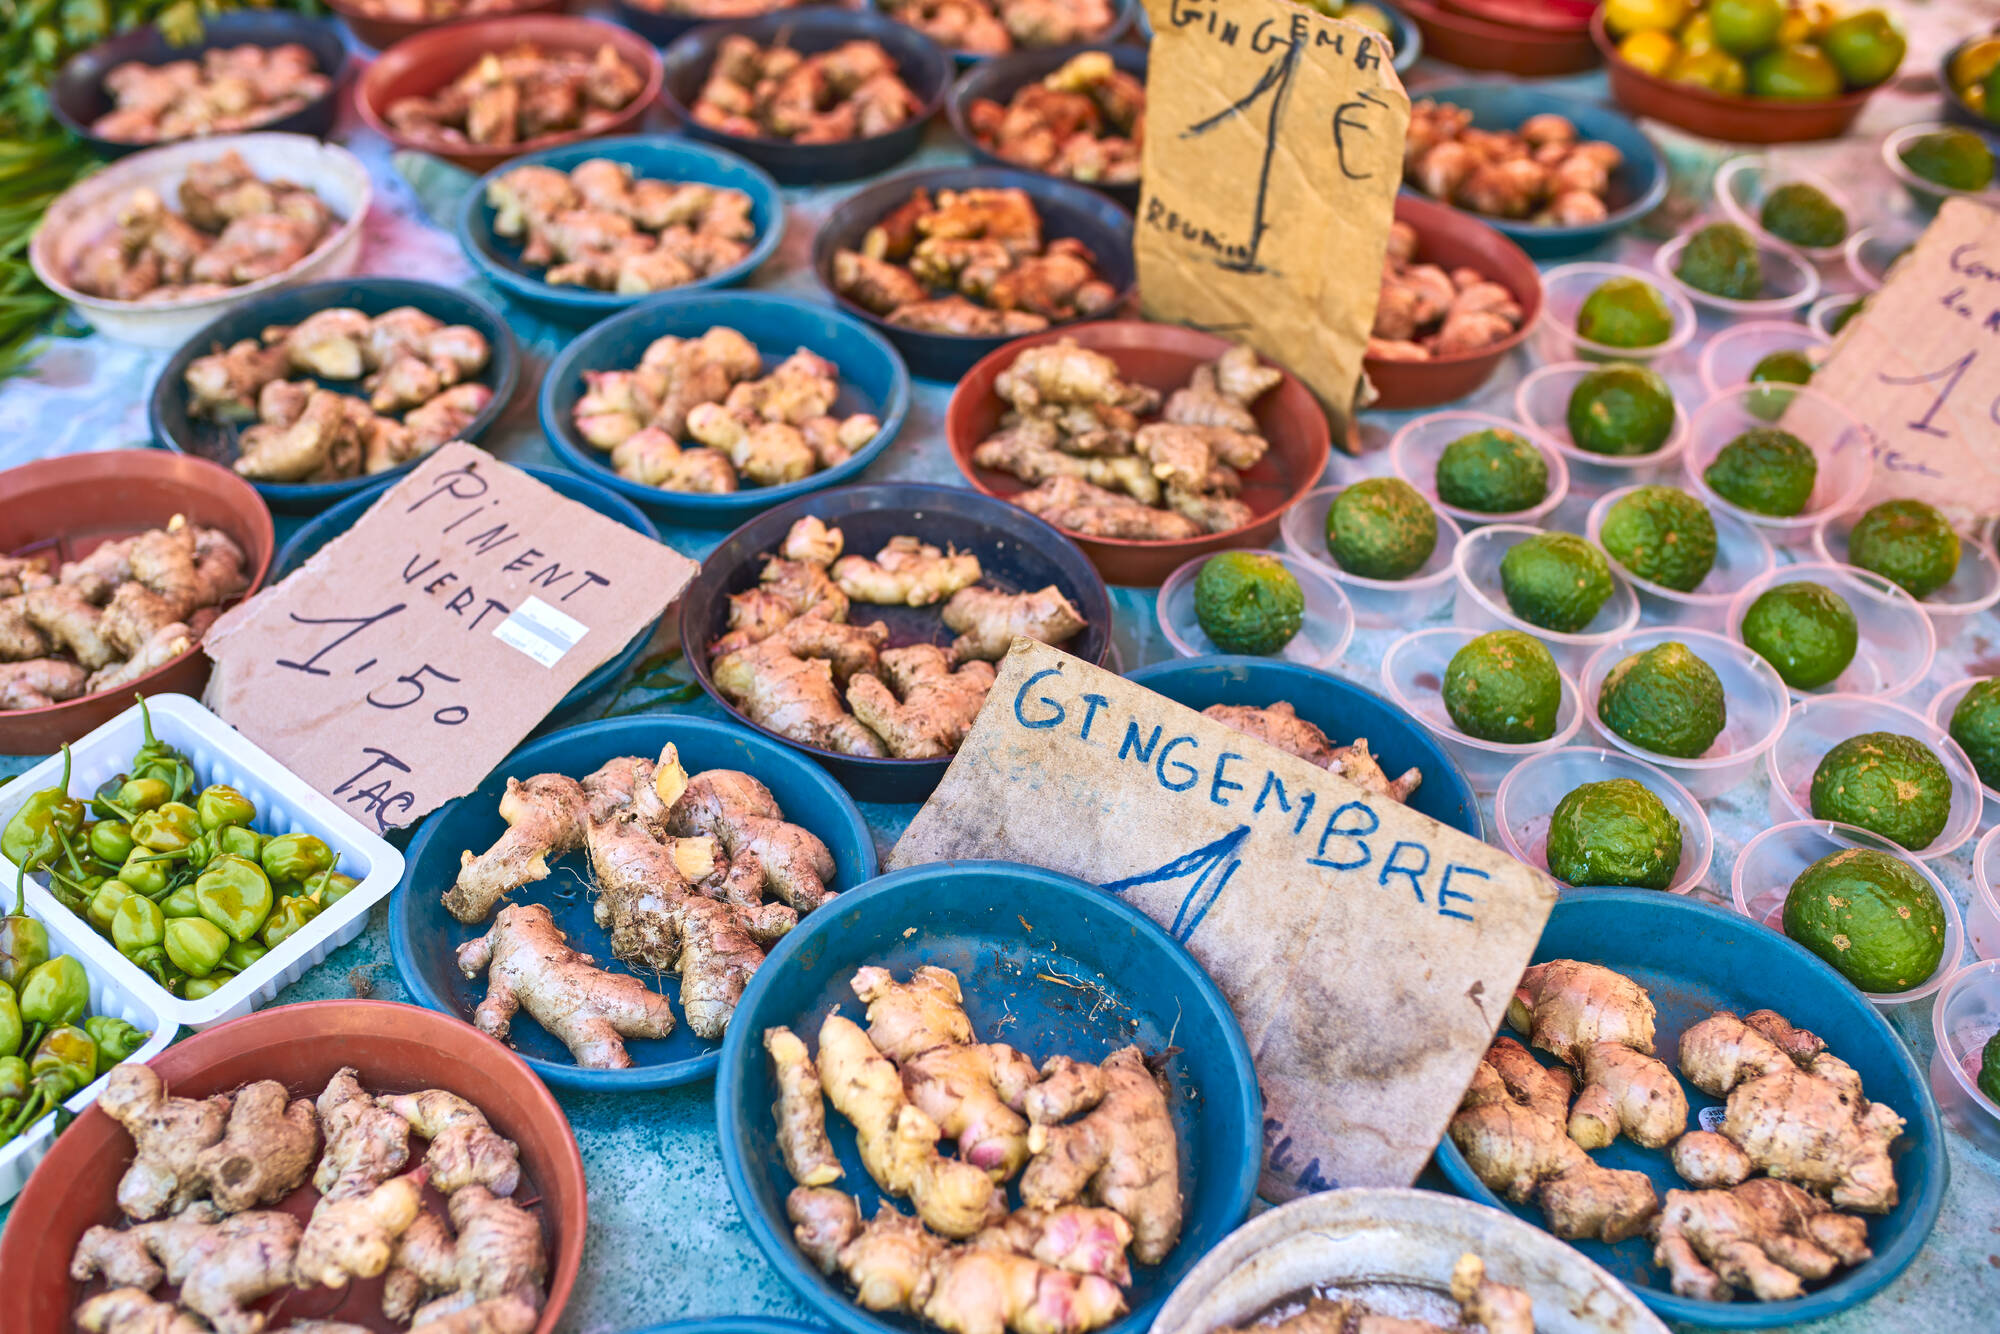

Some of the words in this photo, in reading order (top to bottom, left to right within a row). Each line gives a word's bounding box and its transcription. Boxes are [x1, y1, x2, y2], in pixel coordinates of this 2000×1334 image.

[1877, 349, 1978, 438] 1
[402, 553, 511, 631] VERT
[1013, 668, 1491, 922] GINGEMBRE
